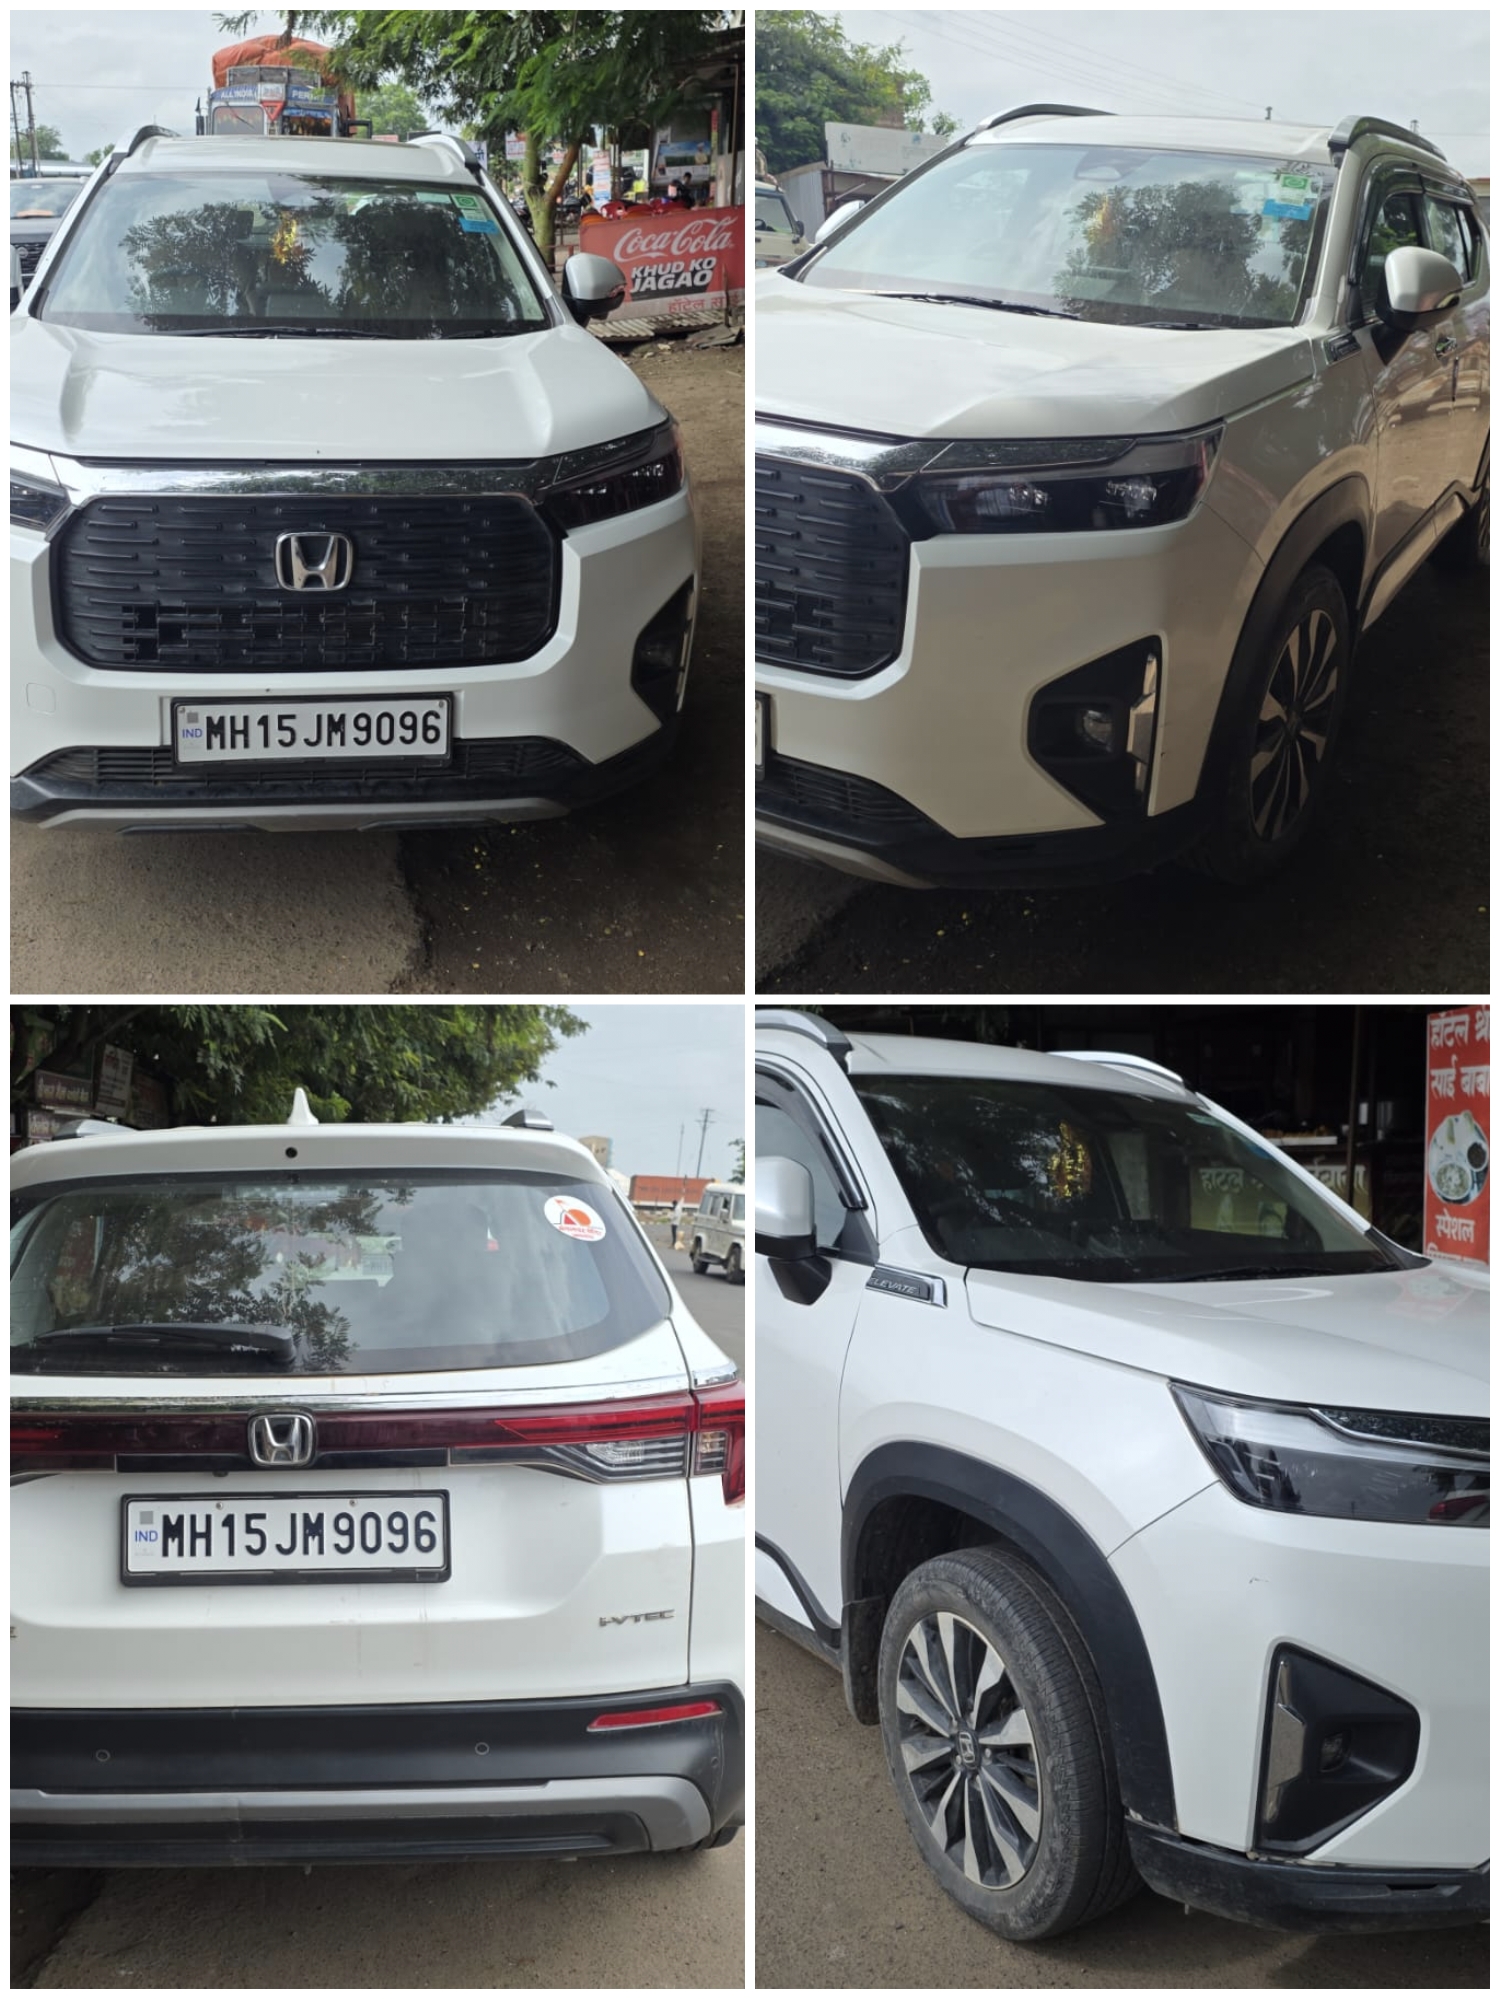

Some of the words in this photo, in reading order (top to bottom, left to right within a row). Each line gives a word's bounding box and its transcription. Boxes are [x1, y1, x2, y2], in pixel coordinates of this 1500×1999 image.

[613, 216, 738, 262] Coca-Cola
[629, 270, 713, 293] JAGAO
[631, 261, 685, 279] KHUD
[689, 256, 717, 272] KO
[182, 728, 203, 739] IND
[206, 710, 442, 750] MH15JM9096
[134, 1530, 159, 1542] IND
[161, 1510, 437, 1557] MH15JM9096
